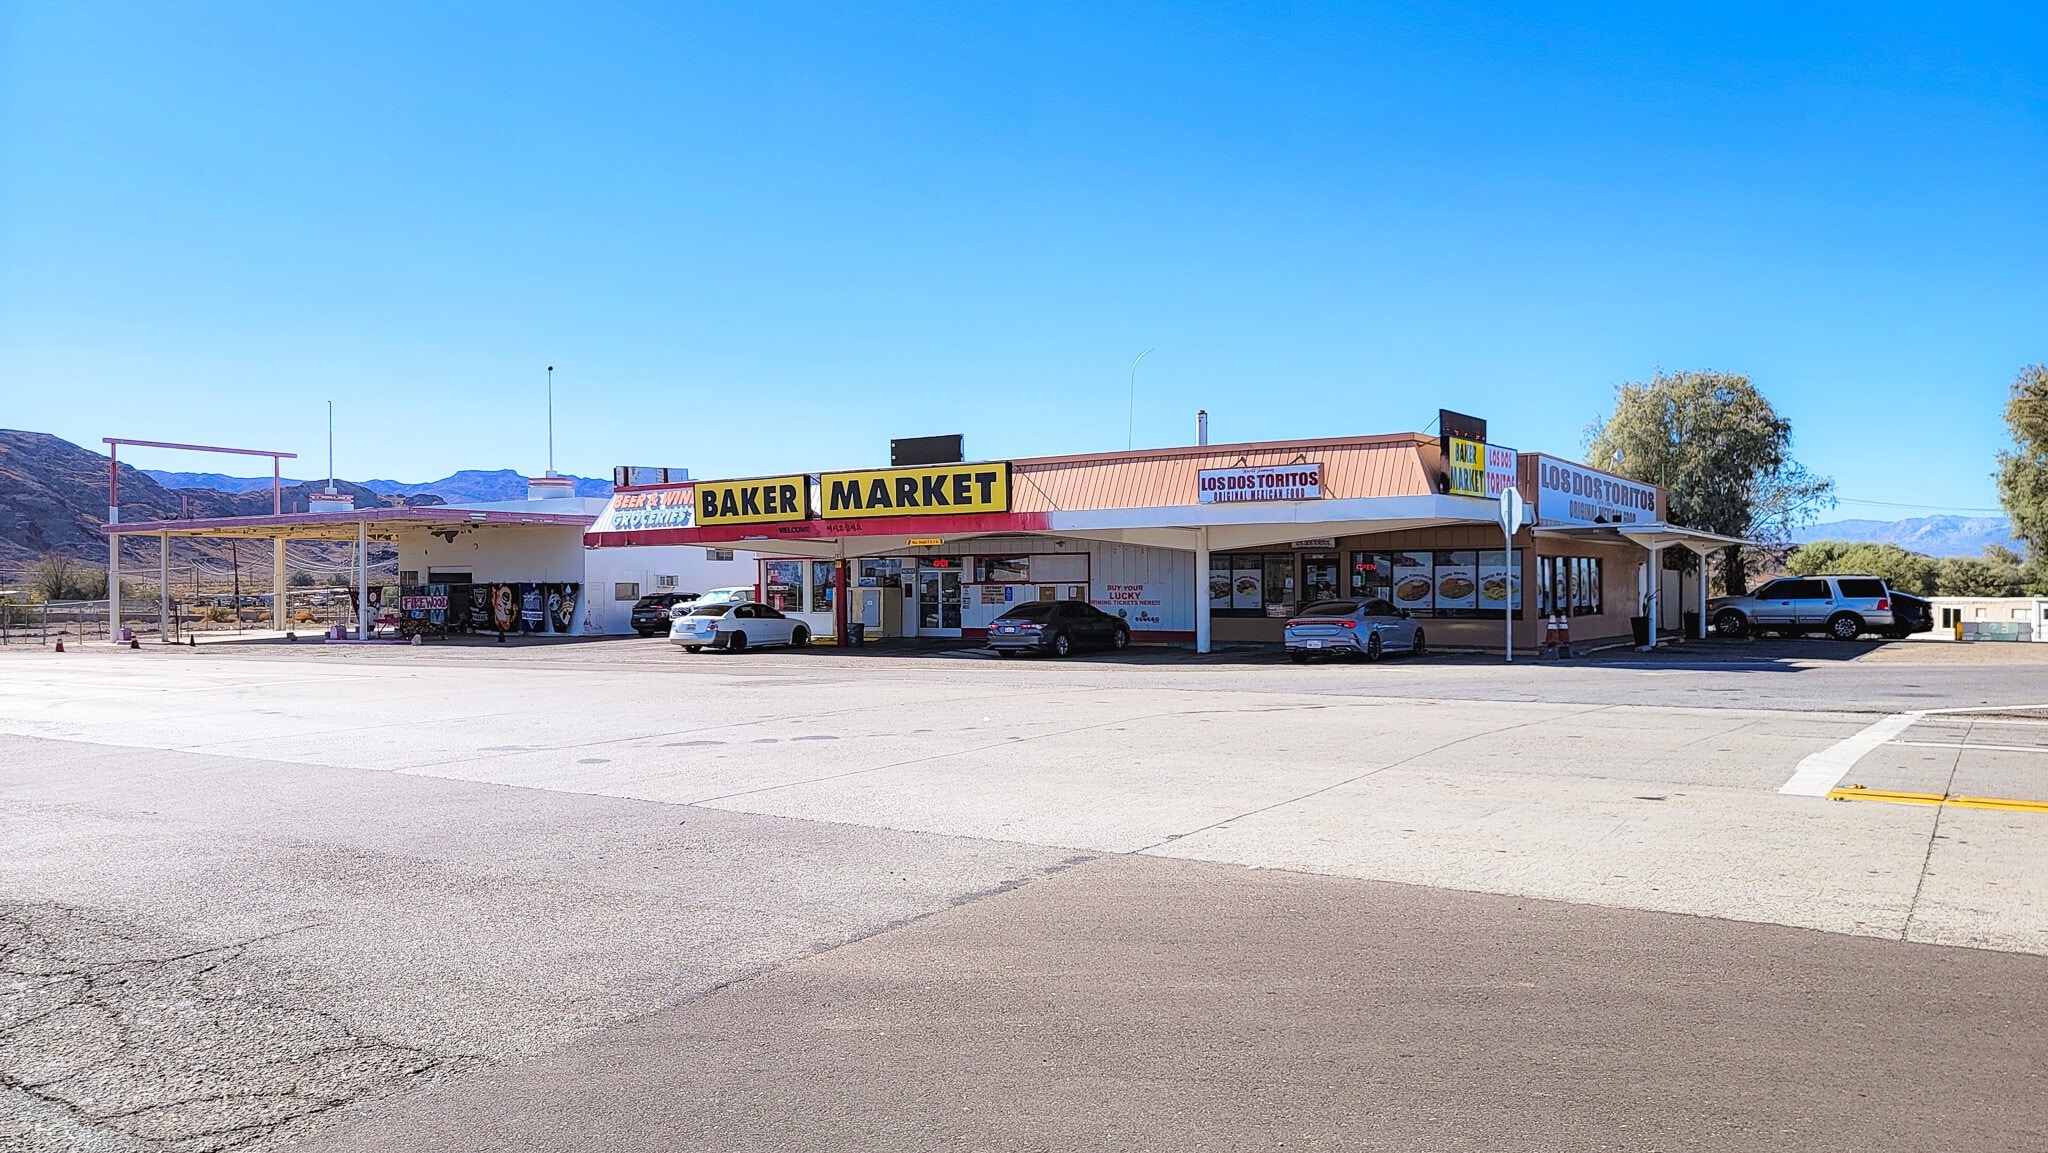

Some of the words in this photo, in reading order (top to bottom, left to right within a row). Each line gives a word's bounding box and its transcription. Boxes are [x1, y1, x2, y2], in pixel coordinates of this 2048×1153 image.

[1455, 443, 1477, 464] BAKER
[1489, 449, 1500, 467] LOS
[1501, 451, 1512, 469] DOS
[1201, 476, 1225, 491] LOS
[1227, 475, 1256, 490] DOS
[1256, 471, 1318, 489] TORITOS
[1451, 466, 1484, 493] MARKET
[1541, 463, 1571, 493] LOS
[1572, 471, 1603, 501] DOS
[1603, 480, 1655, 512] TORITOS
[613, 493, 647, 509] BEER
[647, 492, 659, 507] &
[701, 484, 799, 518] BAKER
[829, 472, 997, 511] MARKET
[1213, 490, 1247, 502] ORIGINAL
[1250, 488, 1282, 500] MEXICAN
[1286, 488, 1305, 499] FOOD
[611, 508, 689, 528] GROCERIES
[778, 525, 811, 534] WELCOME
[1355, 563, 1377, 571] OPEN
[403, 597, 449, 610] FIREWOOD
[1109, 592, 1141, 600] LUCKY
